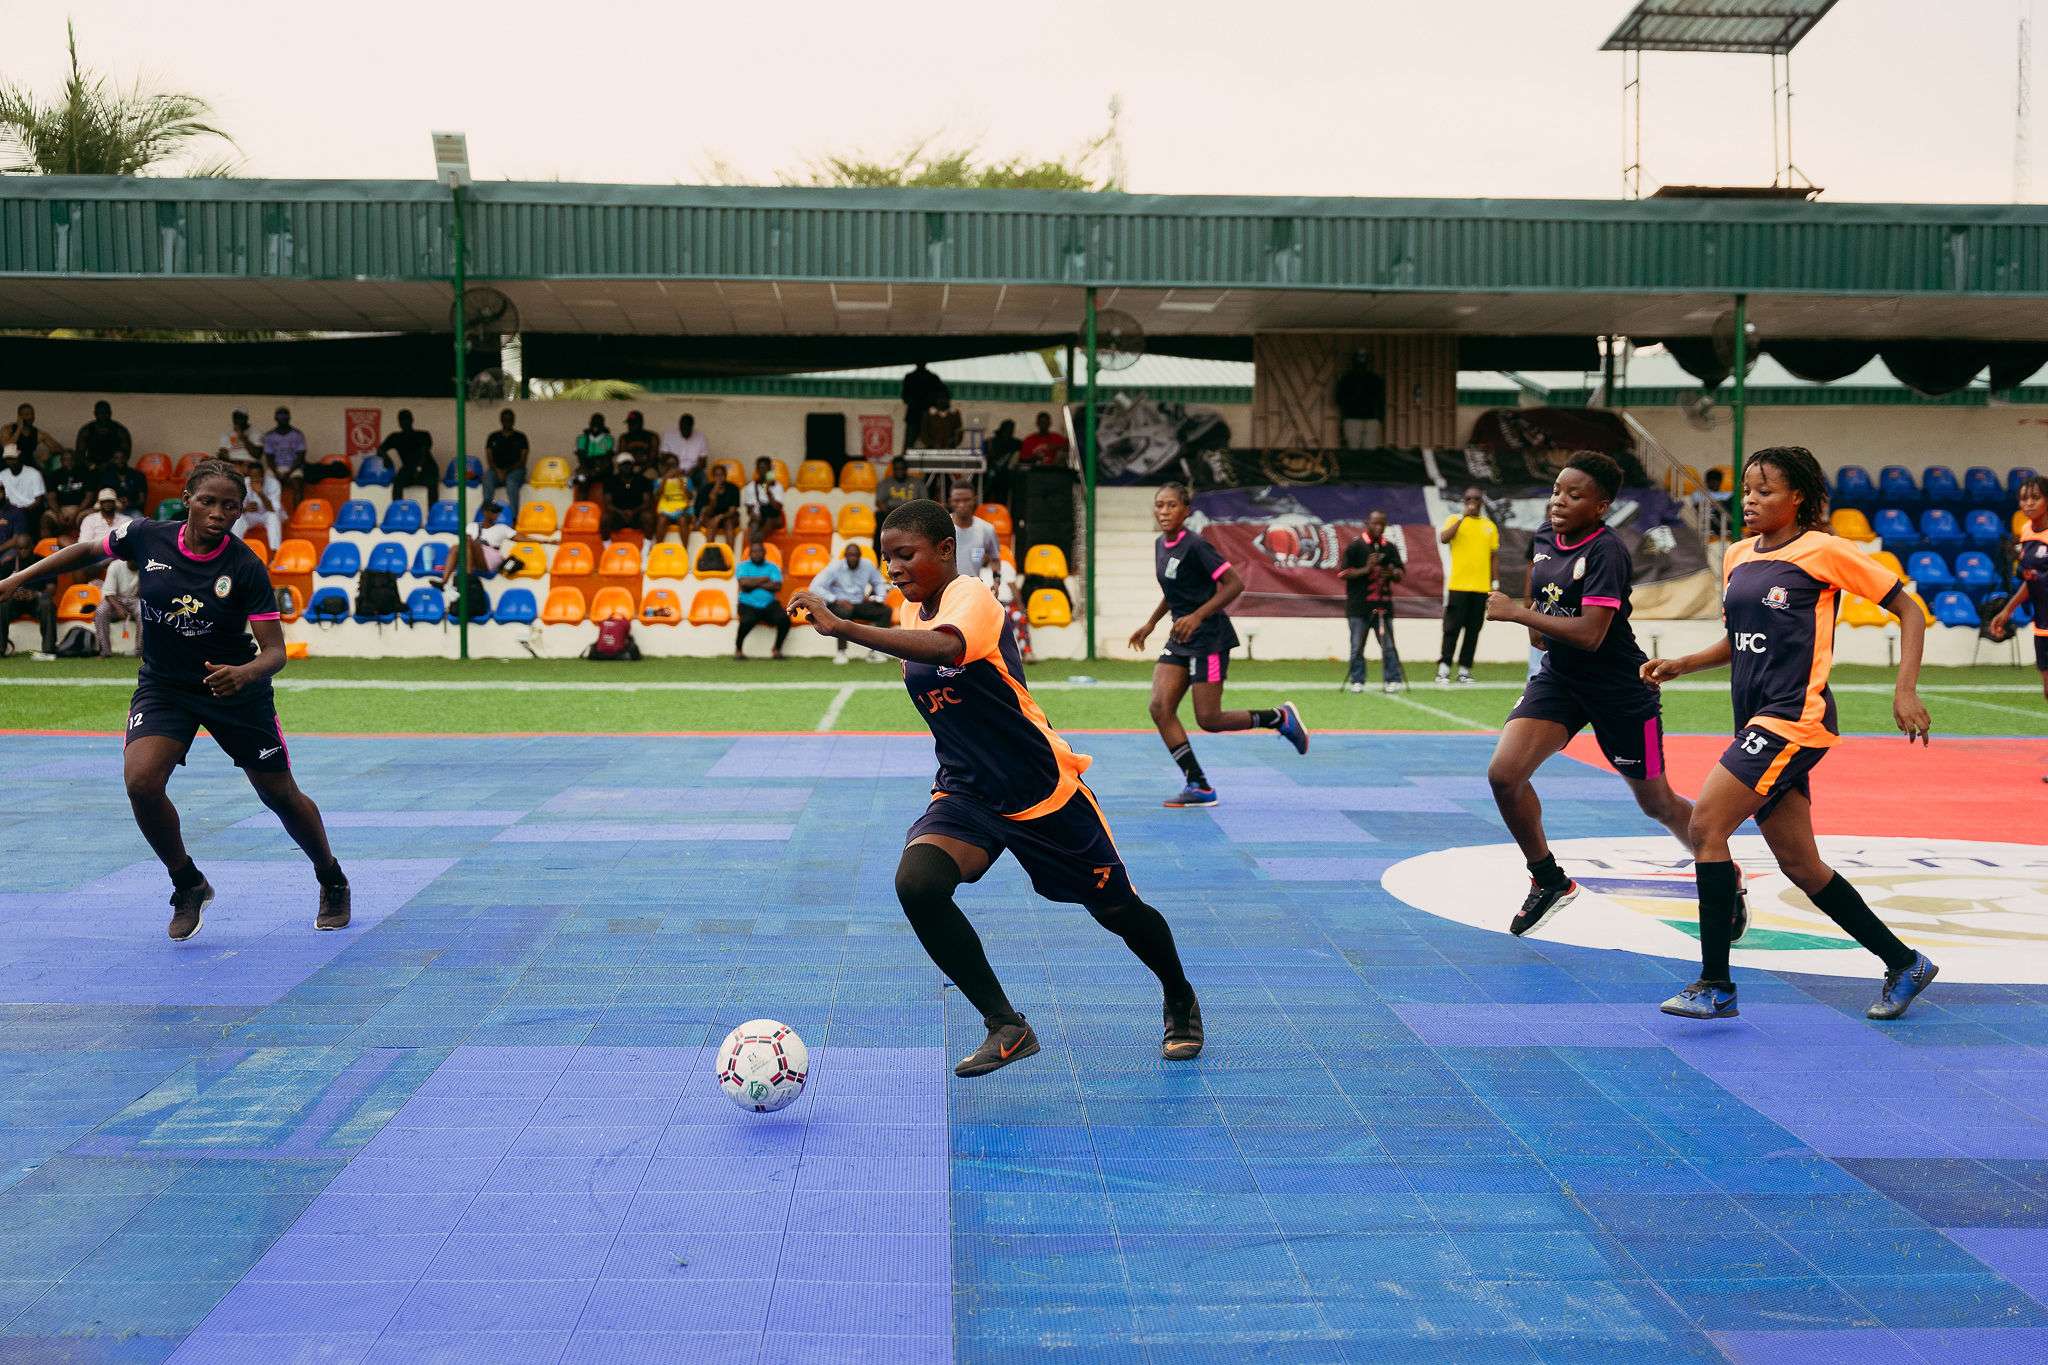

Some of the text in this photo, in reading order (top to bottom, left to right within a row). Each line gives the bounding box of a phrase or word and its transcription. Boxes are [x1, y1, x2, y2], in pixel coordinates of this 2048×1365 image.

[1734, 631, 1767, 654] UFC
[128, 712, 144, 730] 12
[1740, 731, 1769, 755] 15
[1092, 865, 1113, 890] 7
